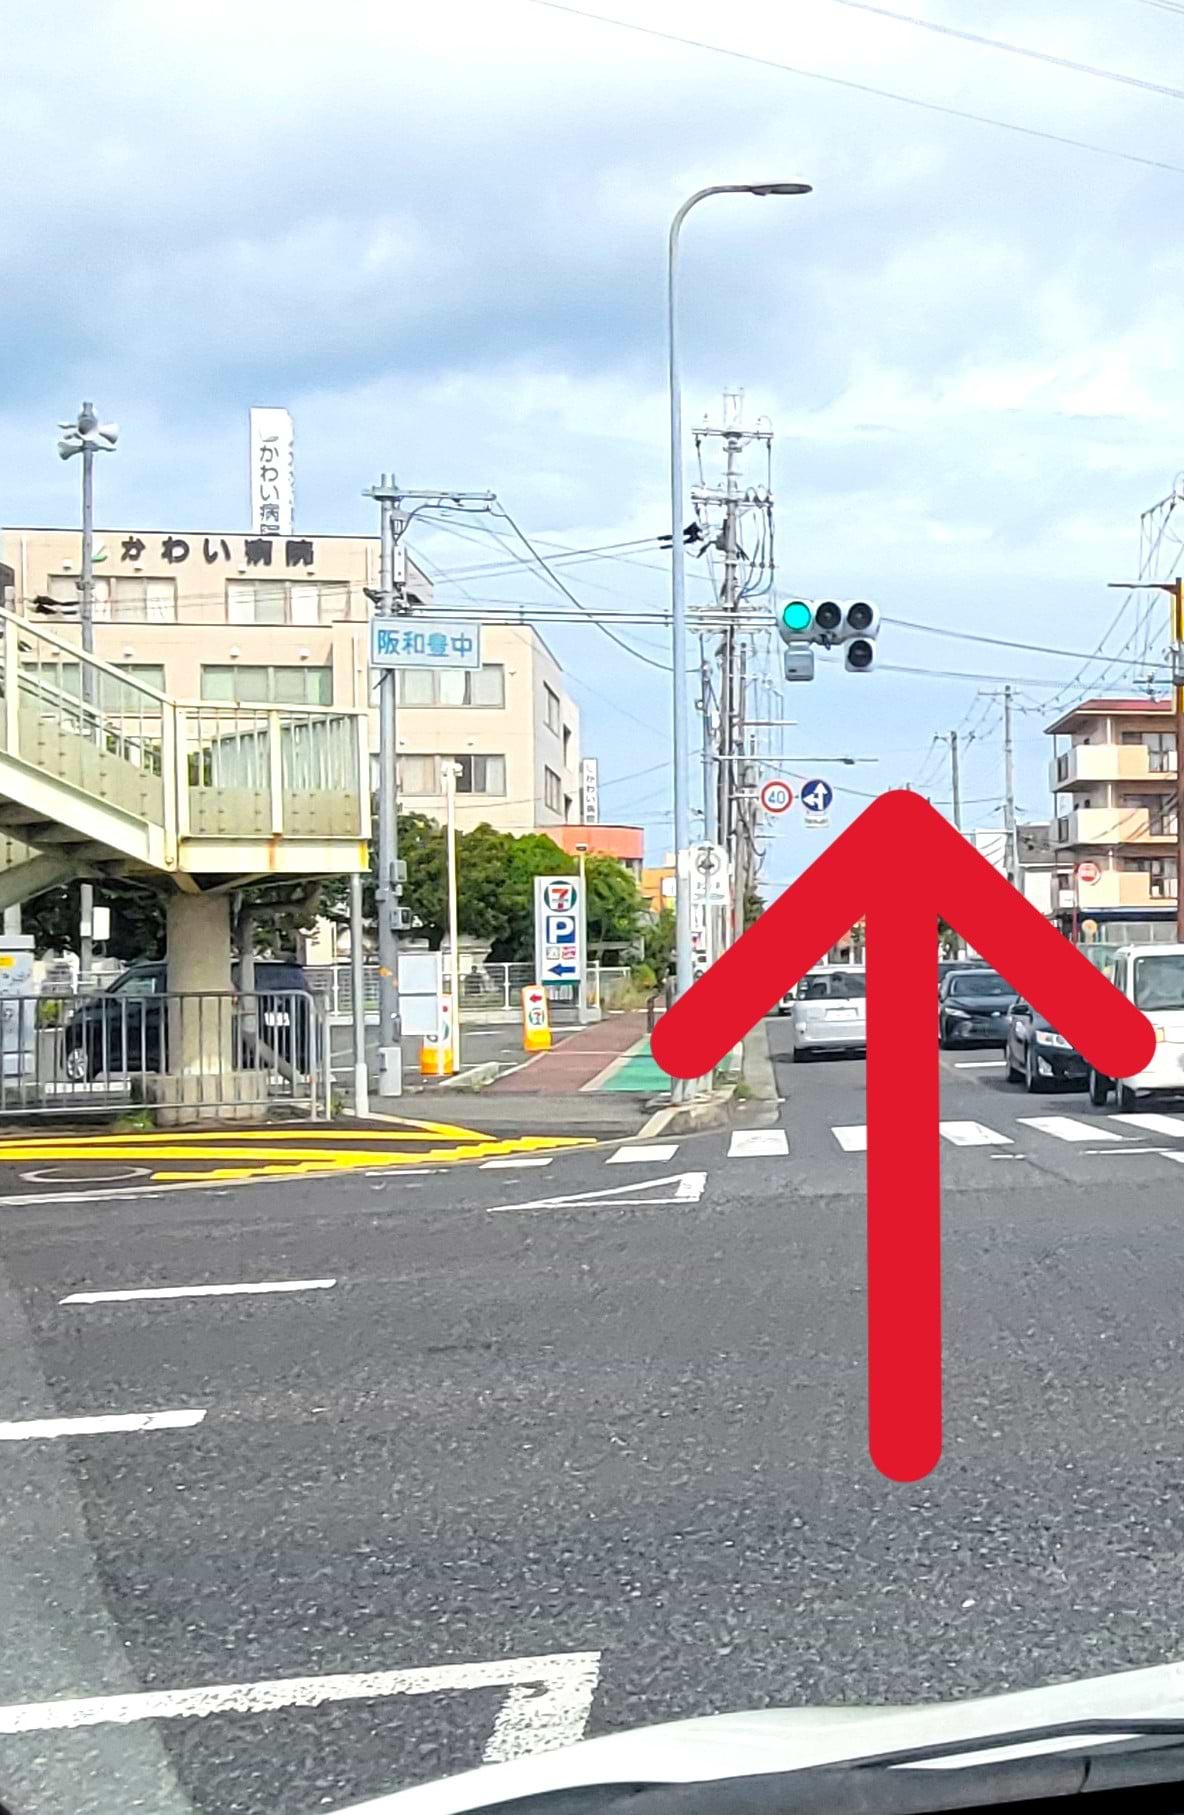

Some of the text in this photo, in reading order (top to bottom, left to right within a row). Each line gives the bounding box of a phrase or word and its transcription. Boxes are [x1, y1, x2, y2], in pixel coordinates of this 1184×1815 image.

[121, 535, 314, 568] かわい病院
[767, 790, 786, 804] 40
[550, 917, 574, 943] P
